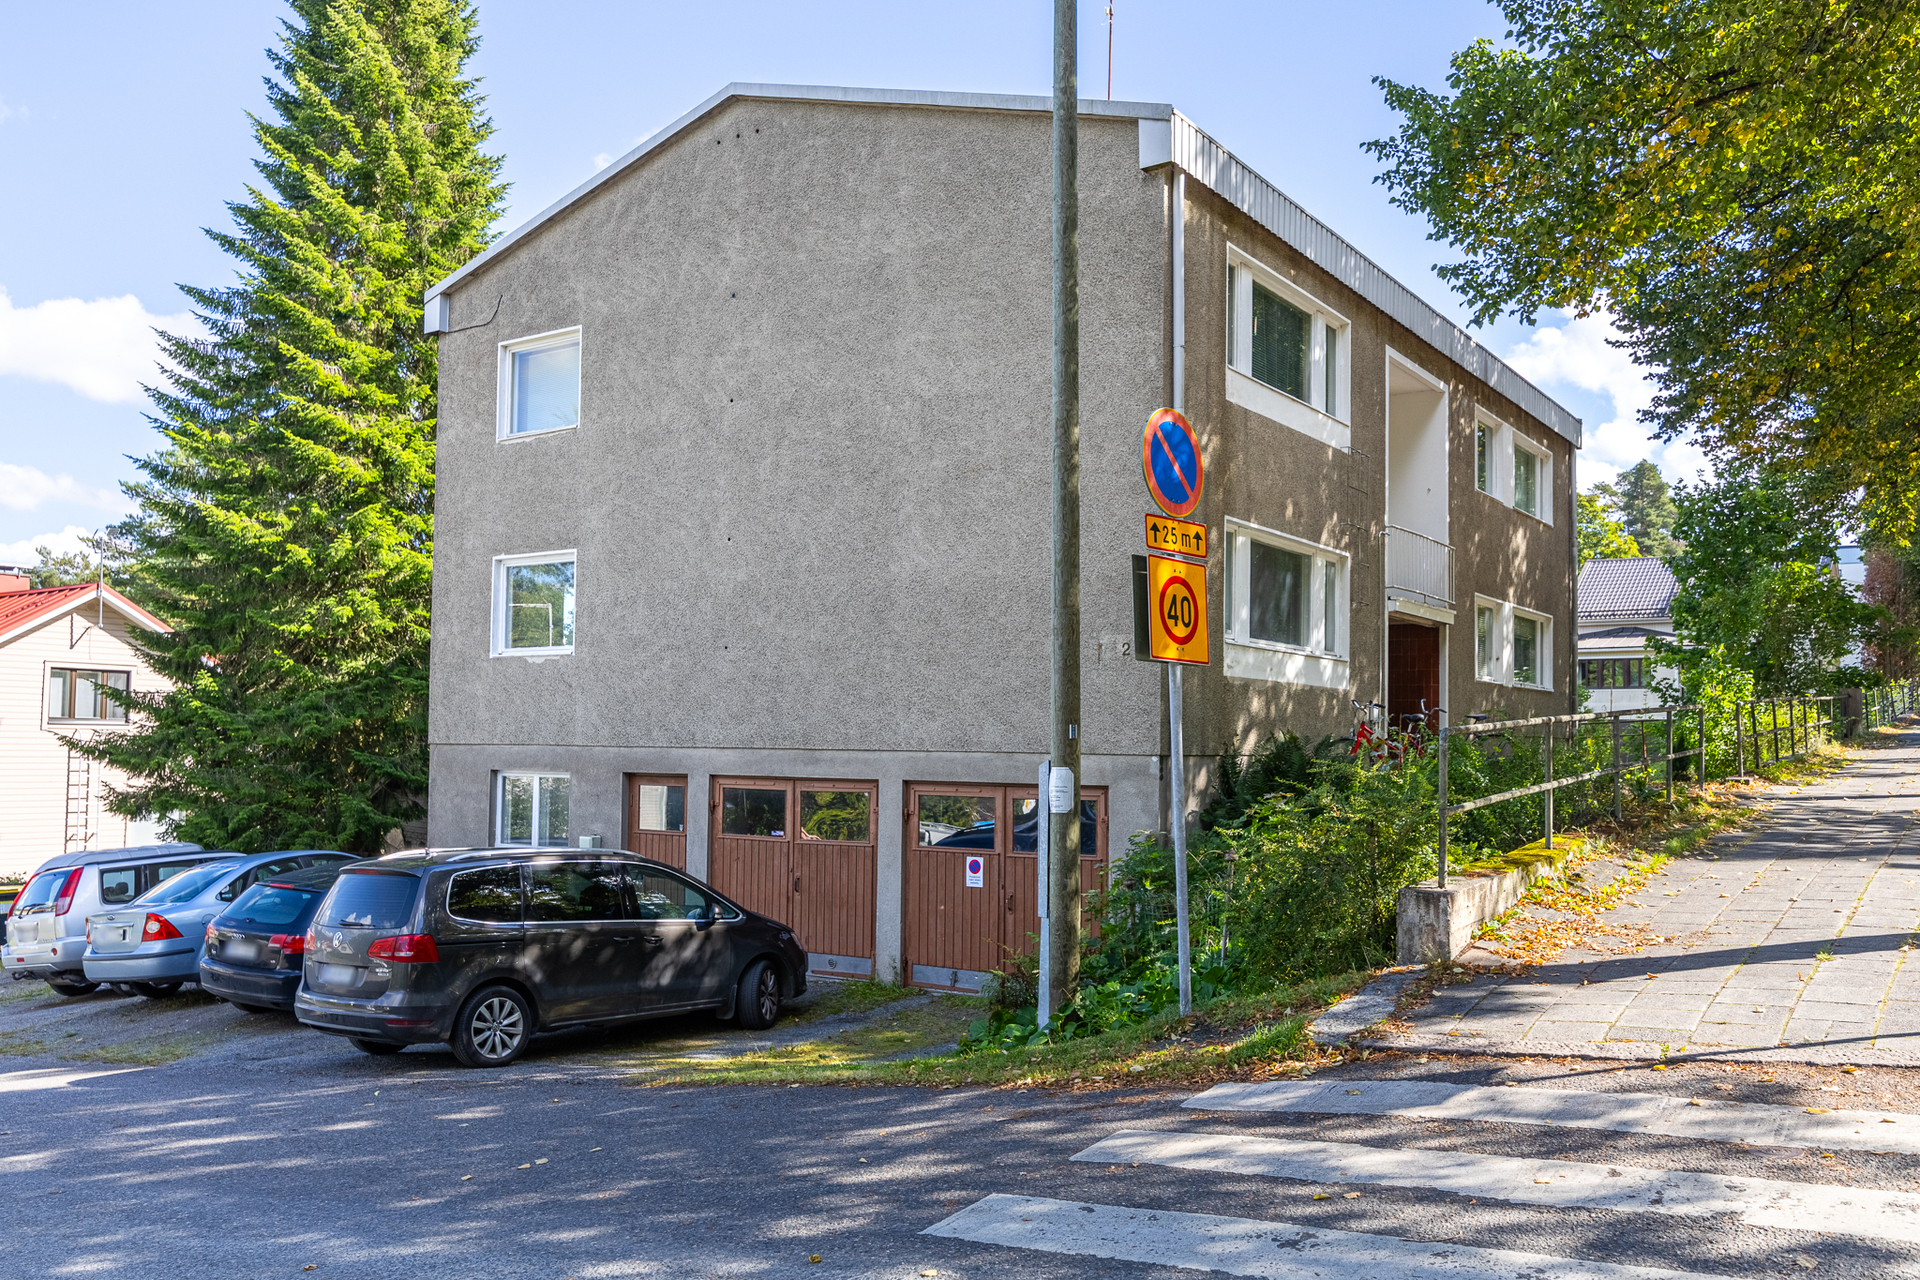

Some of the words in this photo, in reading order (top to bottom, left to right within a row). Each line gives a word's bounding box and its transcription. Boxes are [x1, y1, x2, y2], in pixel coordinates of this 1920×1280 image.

[1162, 525, 1178, 545] 25
[1181, 533, 1191, 548] m
[1167, 594, 1191, 628] 40
[1122, 642, 1131, 656] 2
